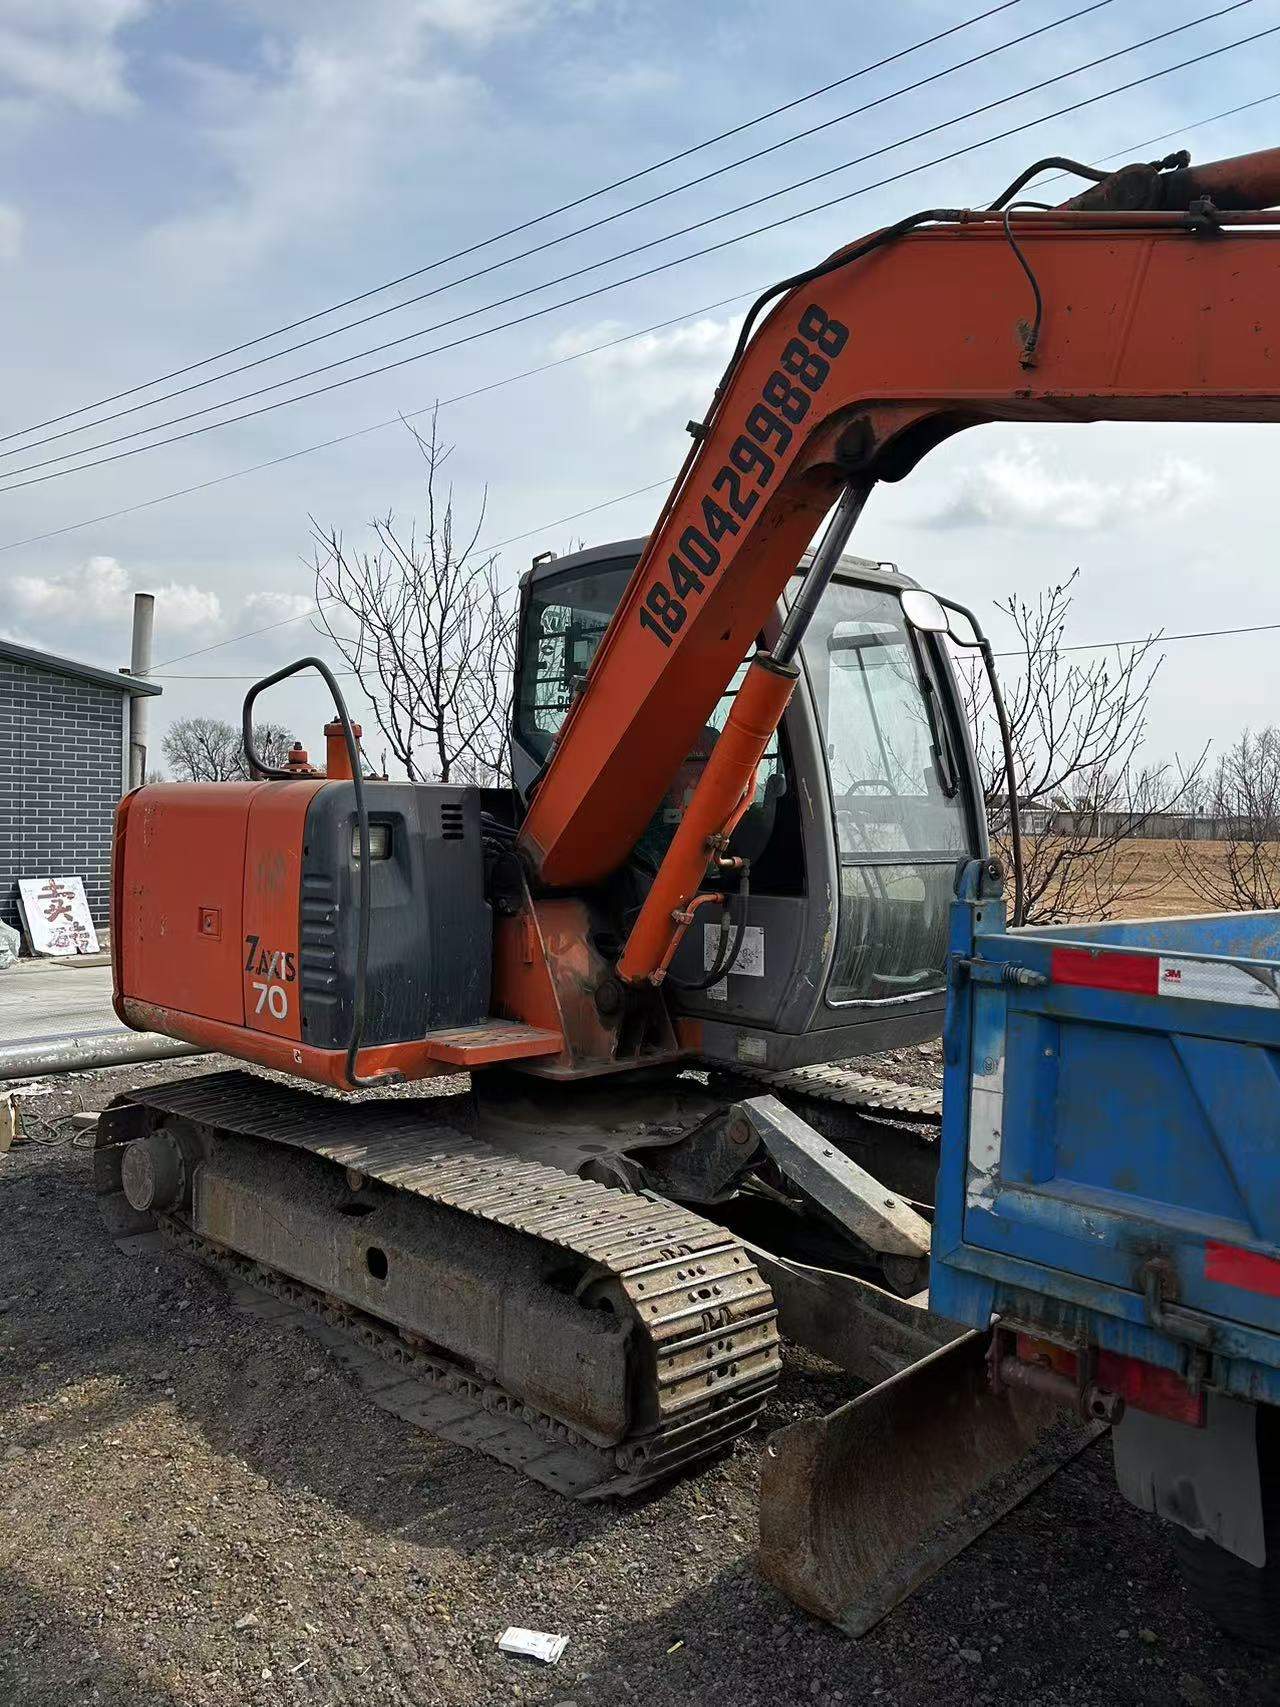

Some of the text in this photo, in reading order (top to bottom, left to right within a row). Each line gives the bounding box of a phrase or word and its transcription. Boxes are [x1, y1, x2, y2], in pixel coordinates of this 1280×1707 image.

[640, 303, 849, 648] 18404299888
[245, 935, 296, 982] ZAXIS
[1164, 969, 1181, 978] 3M
[252, 982, 288, 1019] 70
